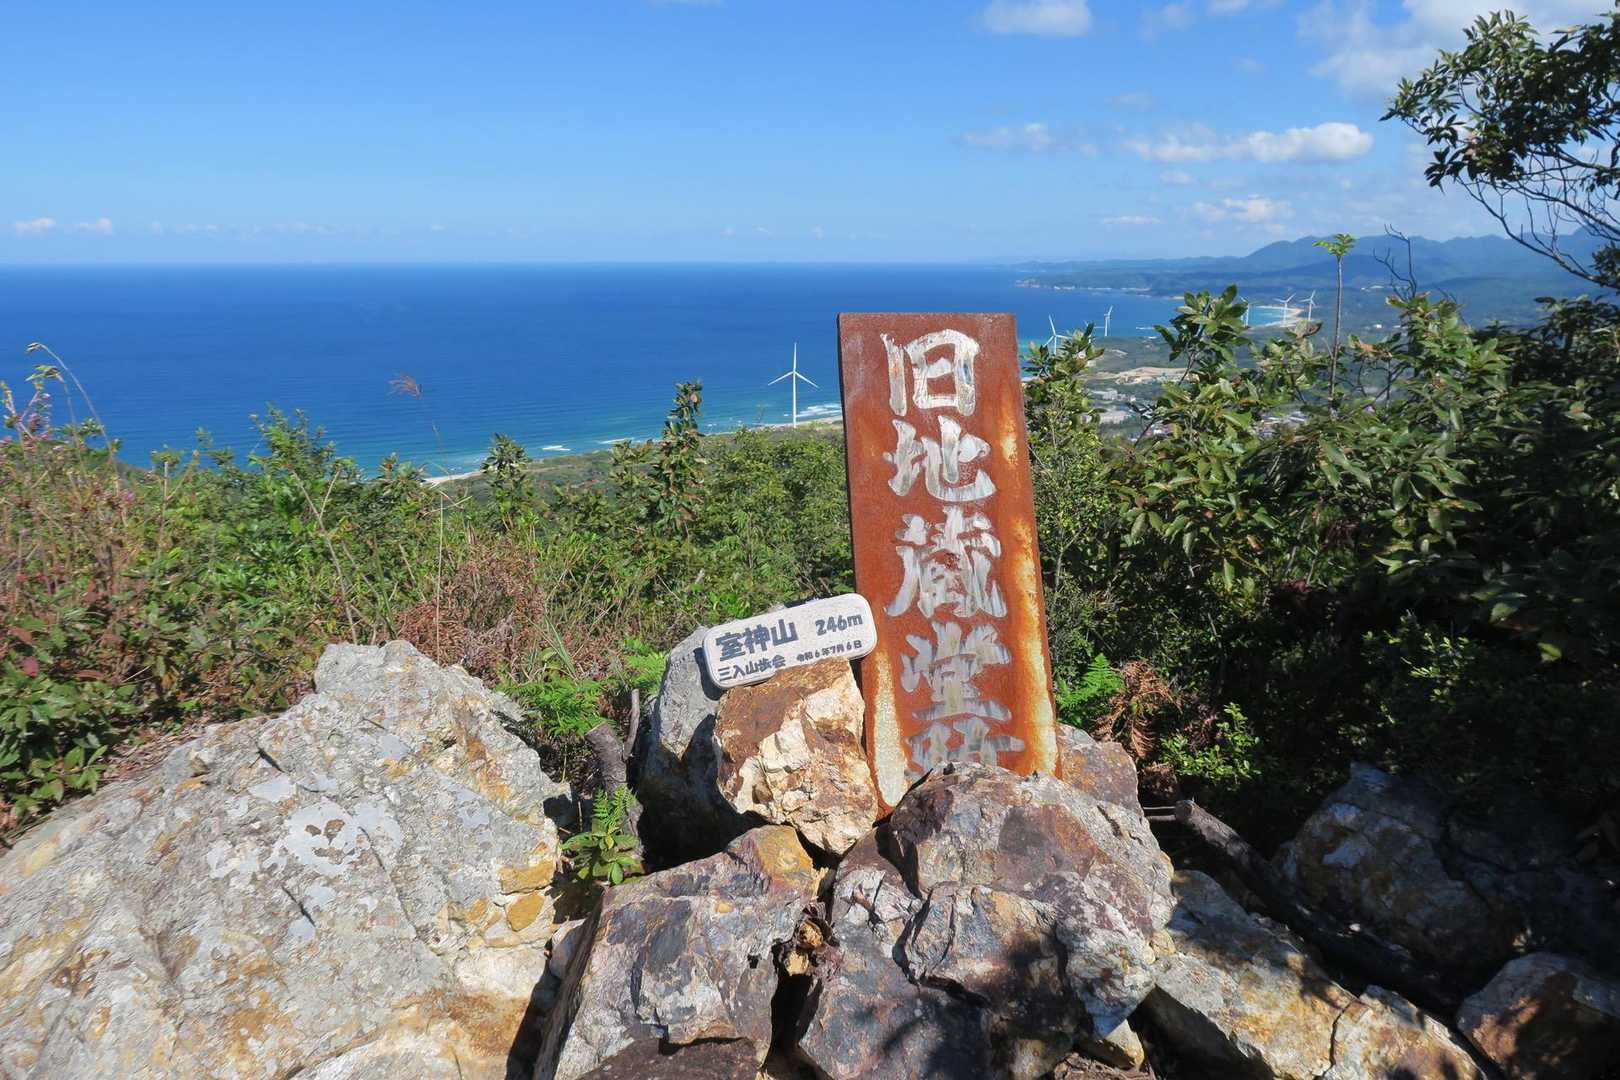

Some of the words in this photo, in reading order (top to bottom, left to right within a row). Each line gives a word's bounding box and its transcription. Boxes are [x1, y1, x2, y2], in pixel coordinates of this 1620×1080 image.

[715, 618, 799, 662] 室神山
[815, 613, 863, 636] 246m
